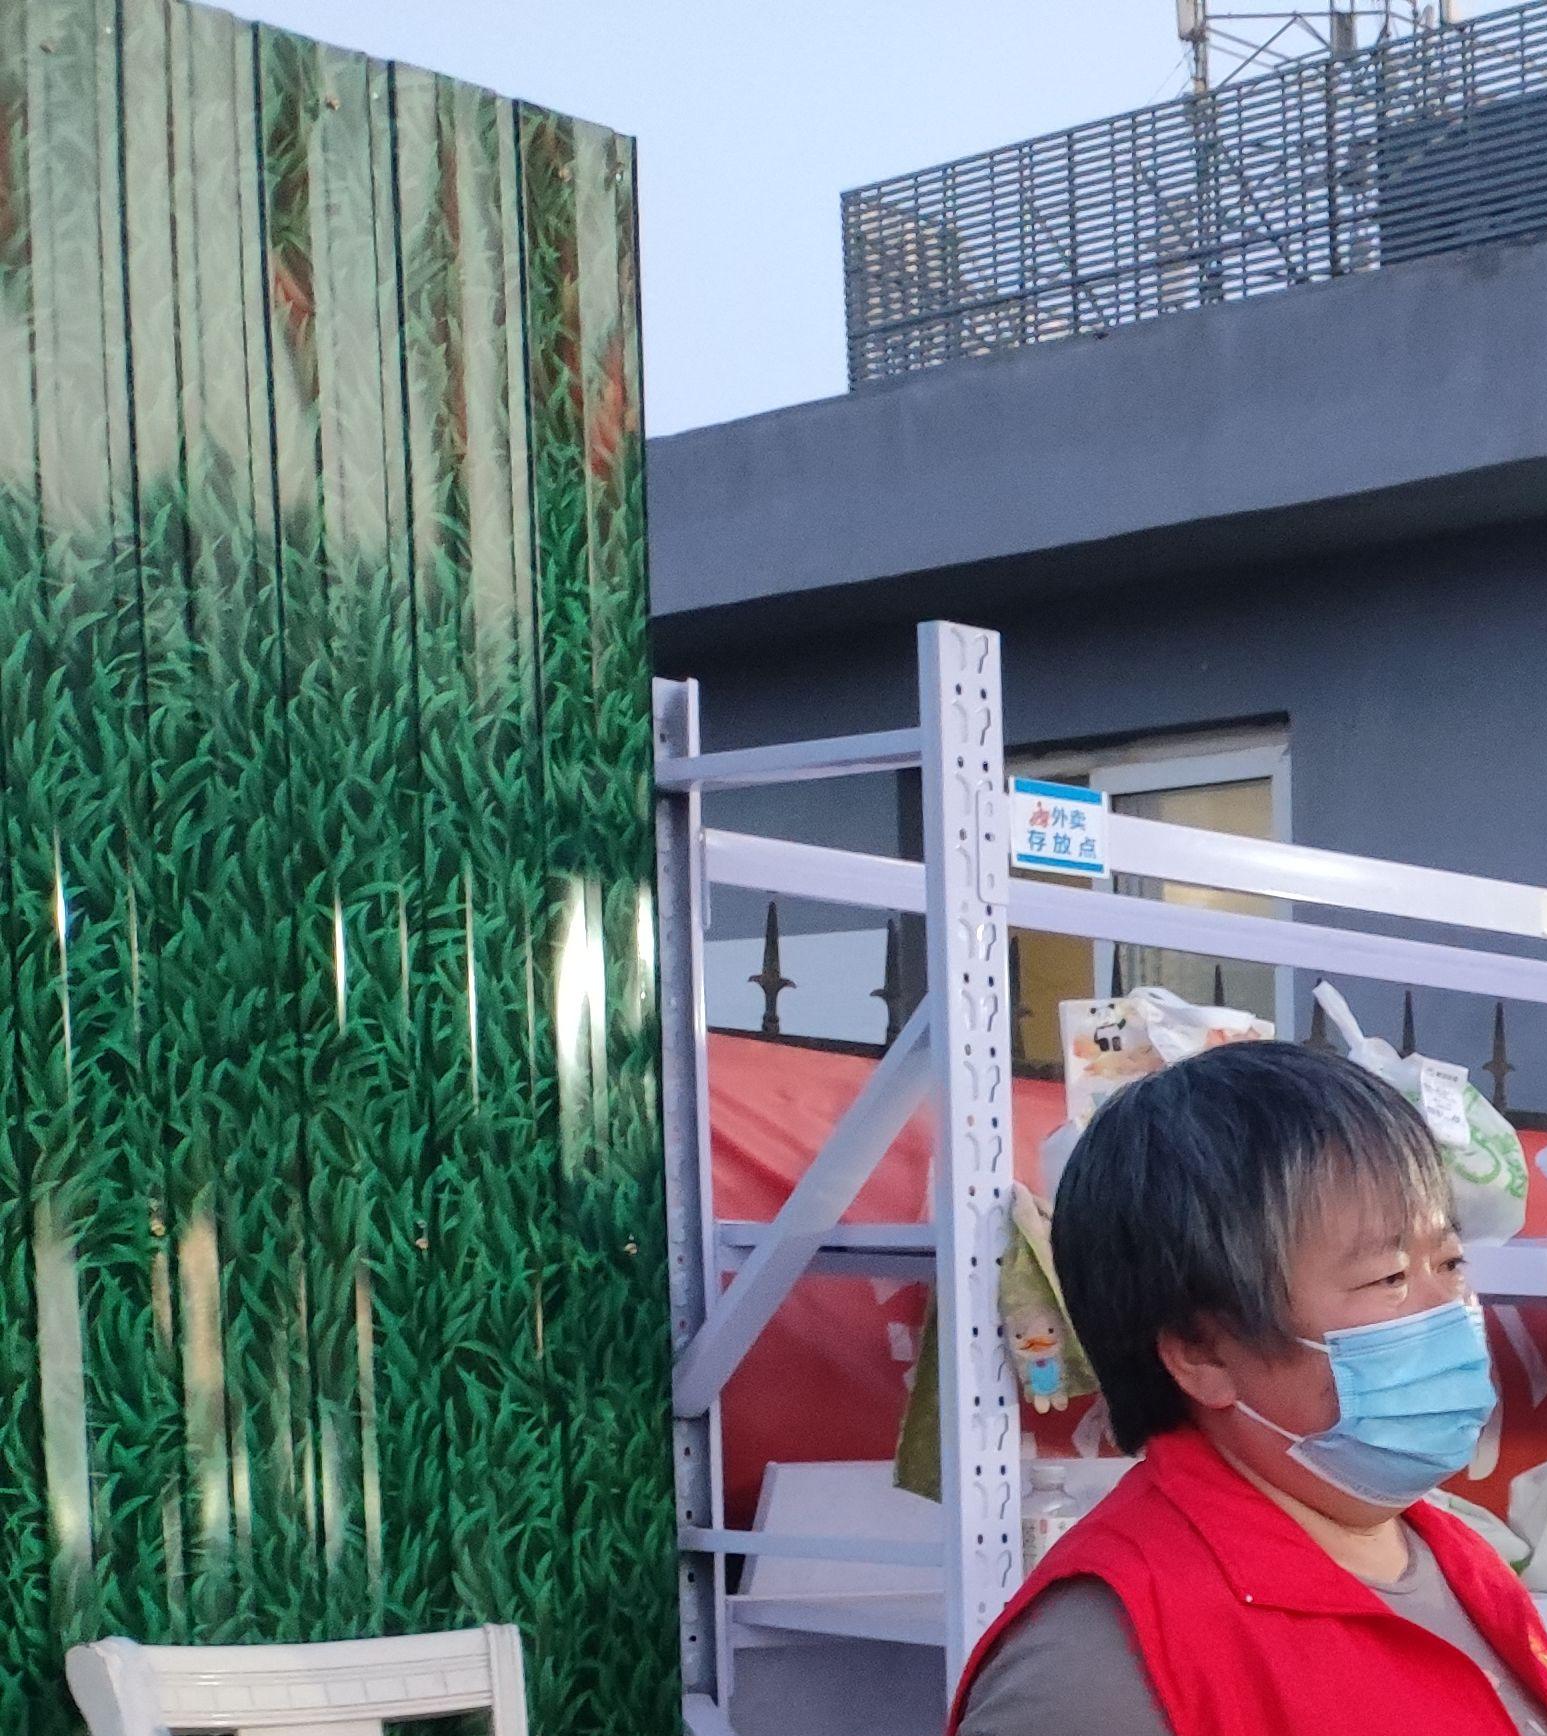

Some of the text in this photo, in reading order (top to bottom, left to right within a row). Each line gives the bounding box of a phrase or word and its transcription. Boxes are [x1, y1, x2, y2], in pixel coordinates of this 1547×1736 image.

[1052, 806, 1086, 831] 外卖
[1027, 829, 1097, 859] 存放点
